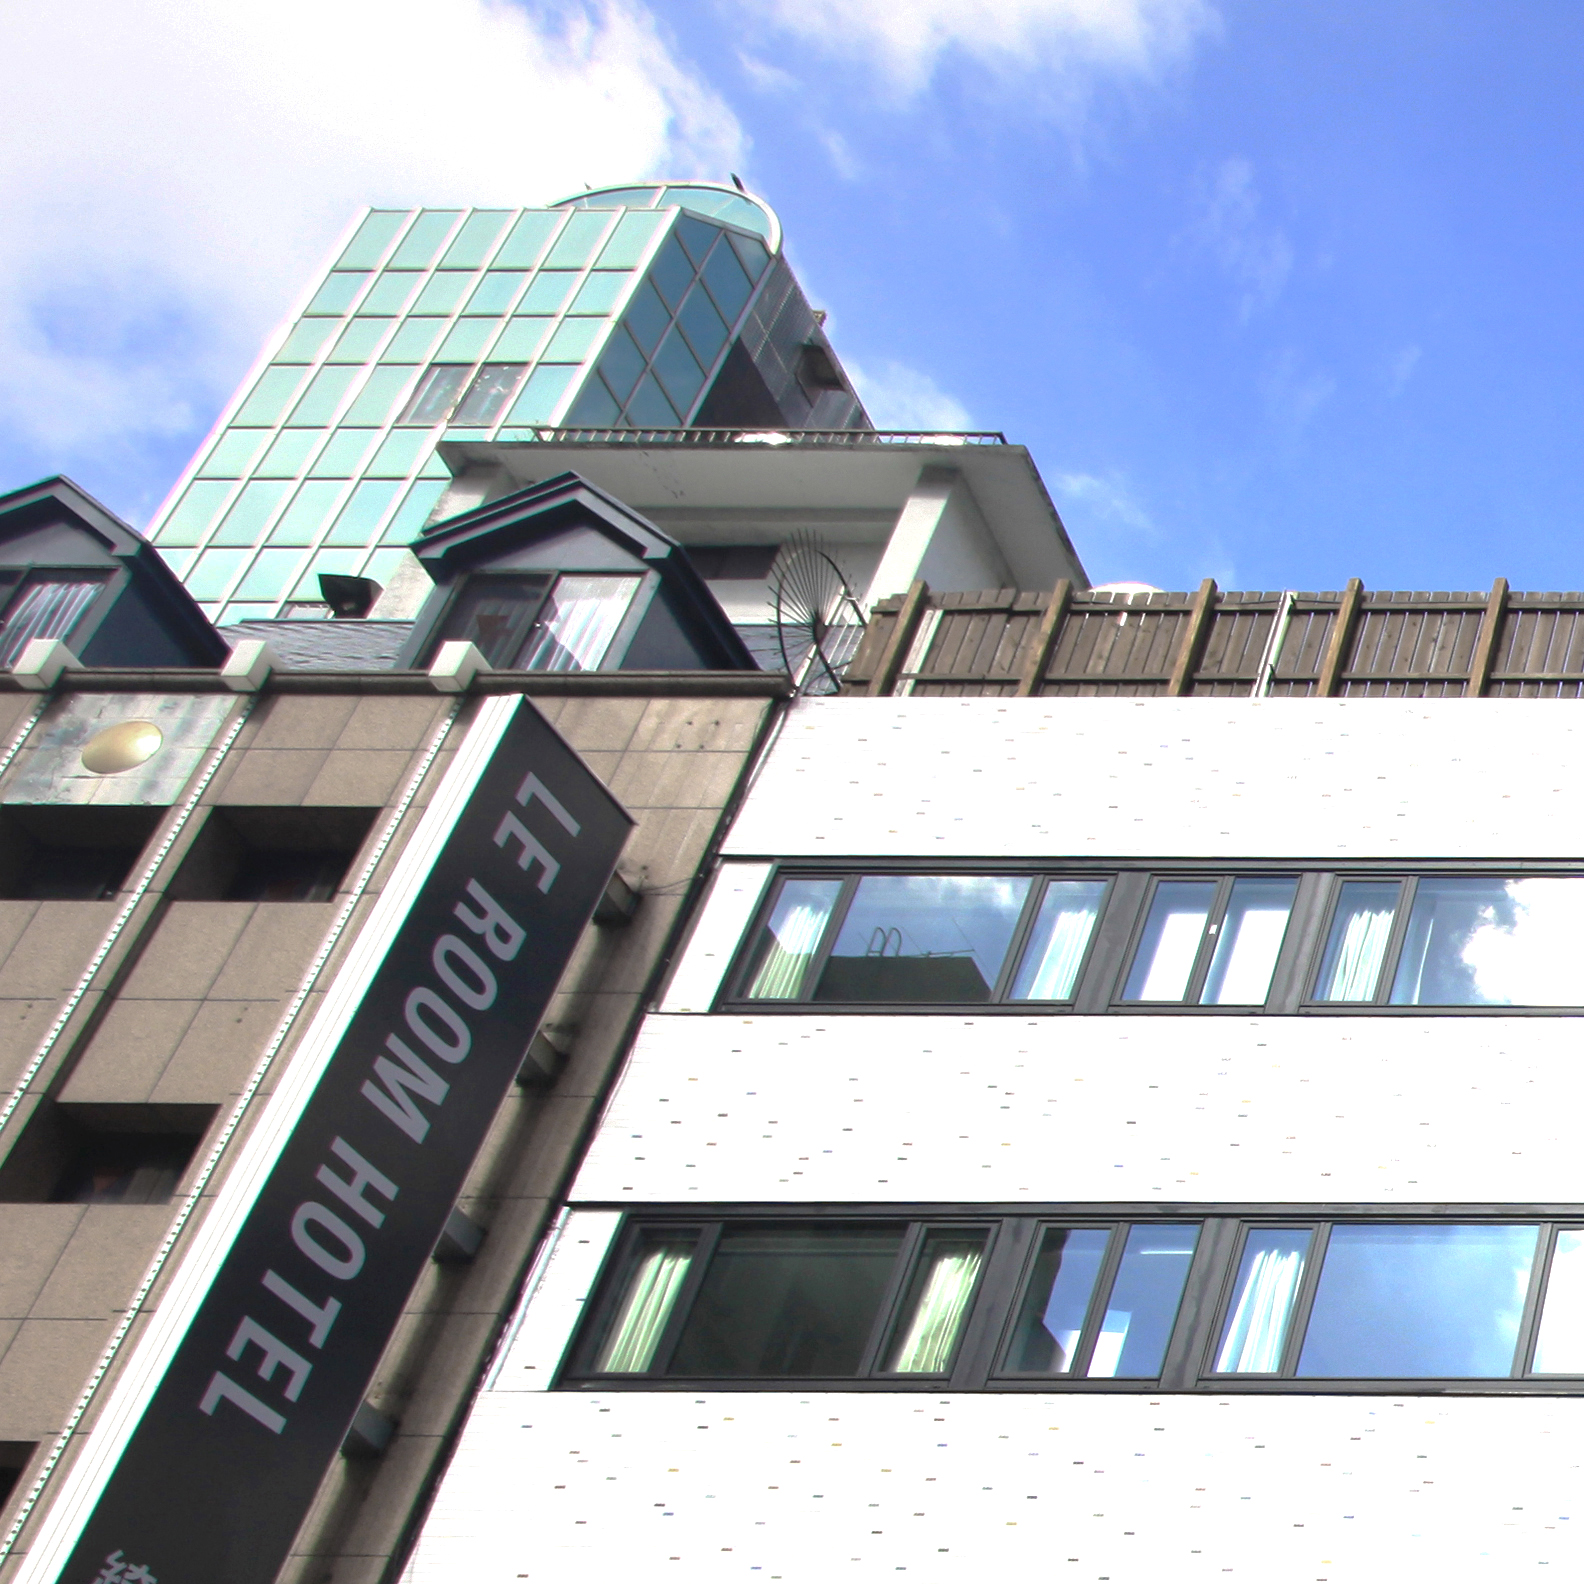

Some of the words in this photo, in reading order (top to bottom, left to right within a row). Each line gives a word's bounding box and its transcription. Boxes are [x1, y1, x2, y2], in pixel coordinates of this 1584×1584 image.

[493, 771, 581, 895] LE
[360, 877, 527, 1145] ROOM
[199, 1135, 400, 1436] HOTEL
